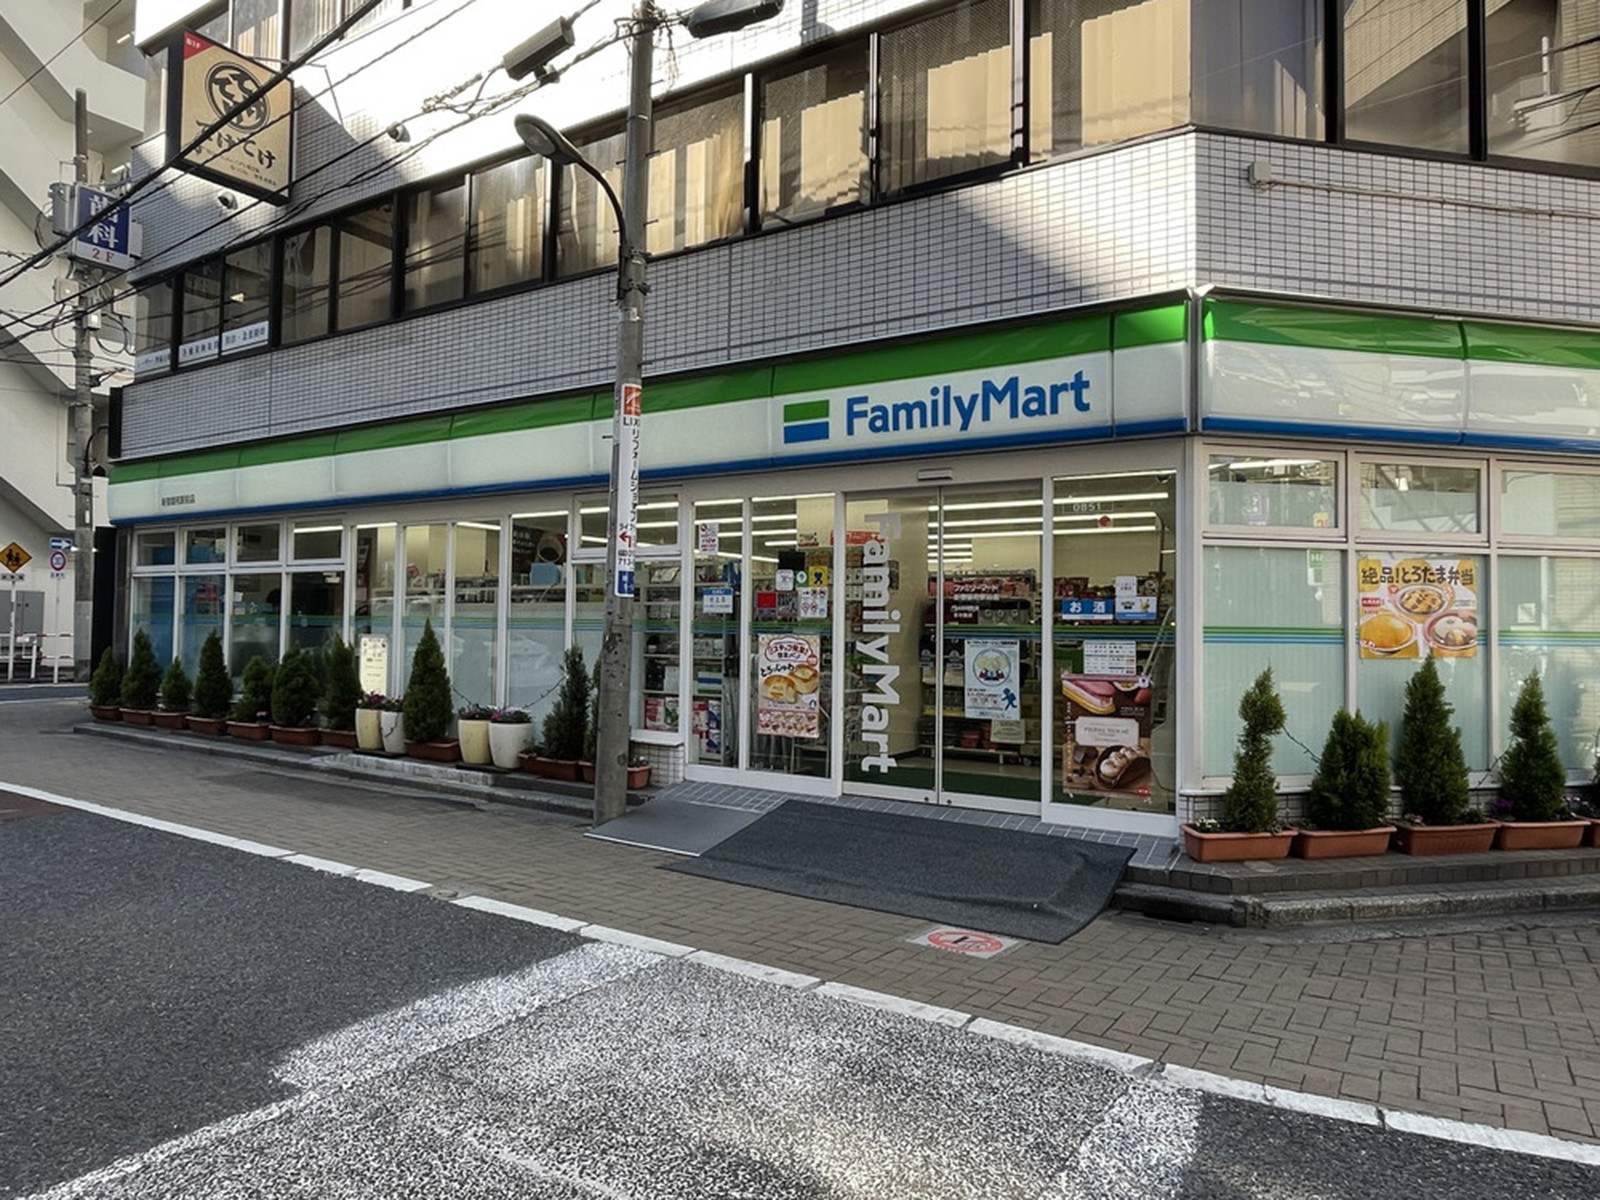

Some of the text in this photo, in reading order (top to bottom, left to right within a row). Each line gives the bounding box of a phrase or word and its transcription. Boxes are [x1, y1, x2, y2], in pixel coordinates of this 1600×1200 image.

[846, 370, 1091, 436] FamilyMart
[1361, 565, 1474, 586] 絶品!とろたま弁当
[856, 512, 903, 774] FamilyMart
